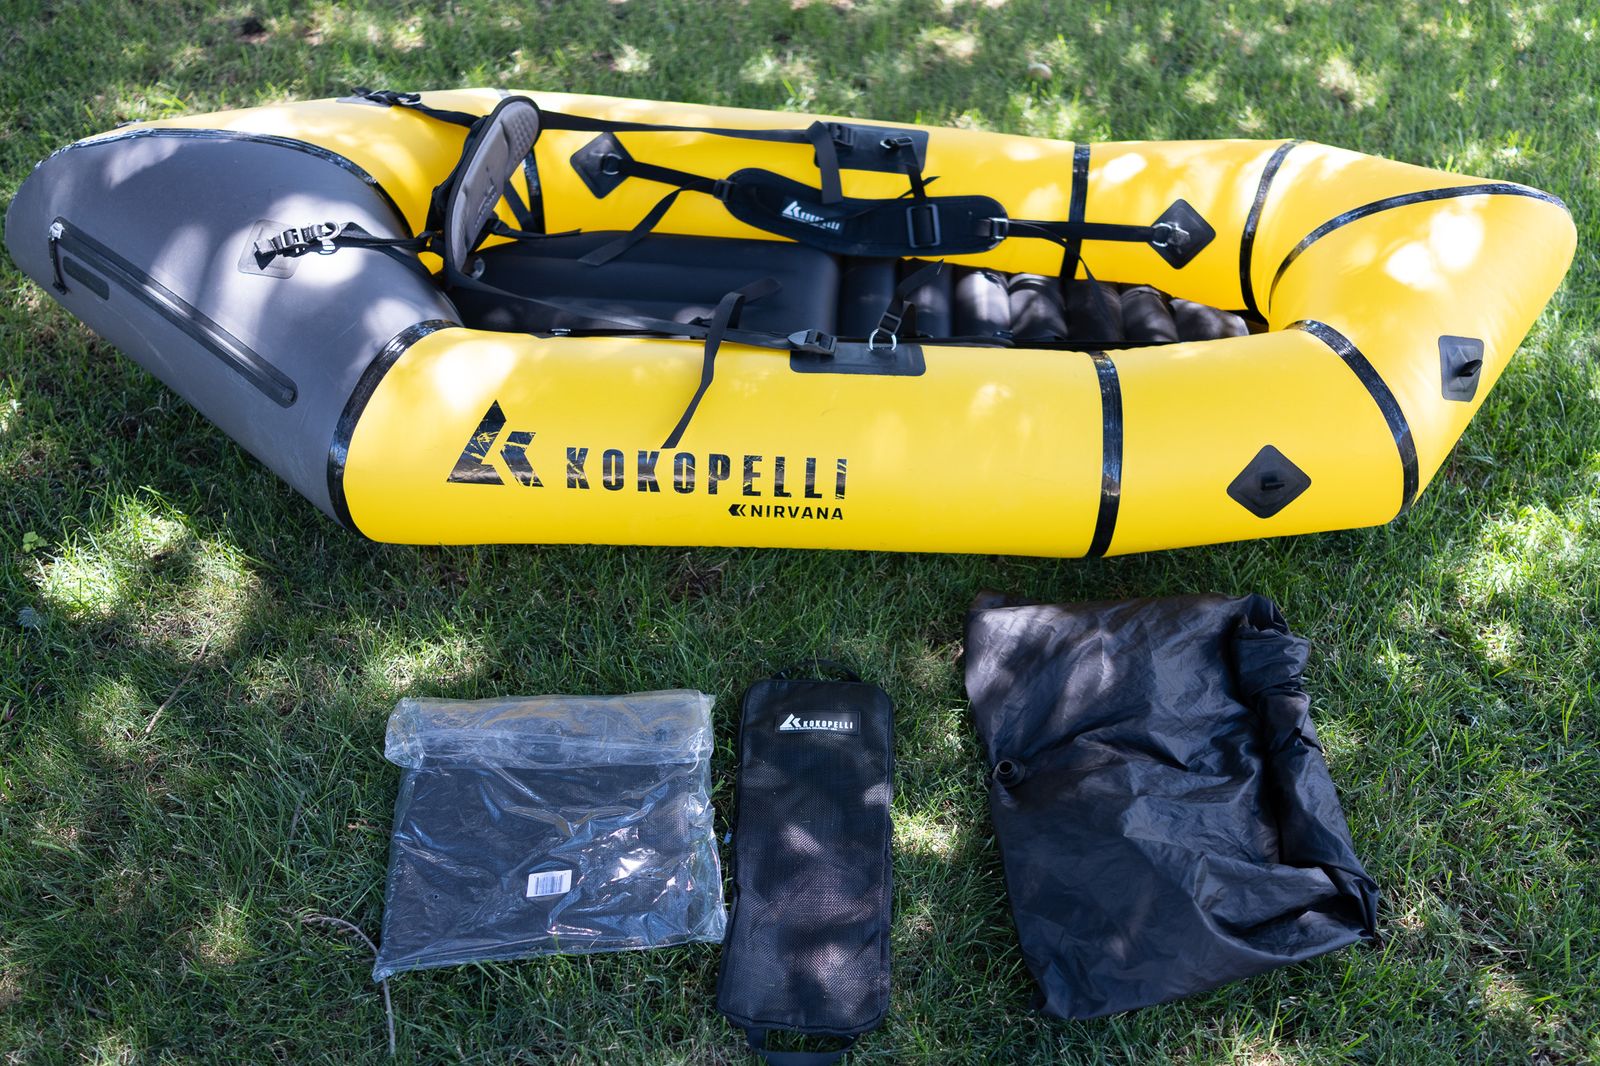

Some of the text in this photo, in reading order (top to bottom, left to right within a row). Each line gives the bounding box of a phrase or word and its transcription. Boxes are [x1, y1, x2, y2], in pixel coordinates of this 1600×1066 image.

[566, 447, 848, 500] KOKOPELLI
[751, 504, 844, 520] NIRVANA
[803, 719, 853, 729] KOKOPELLI
